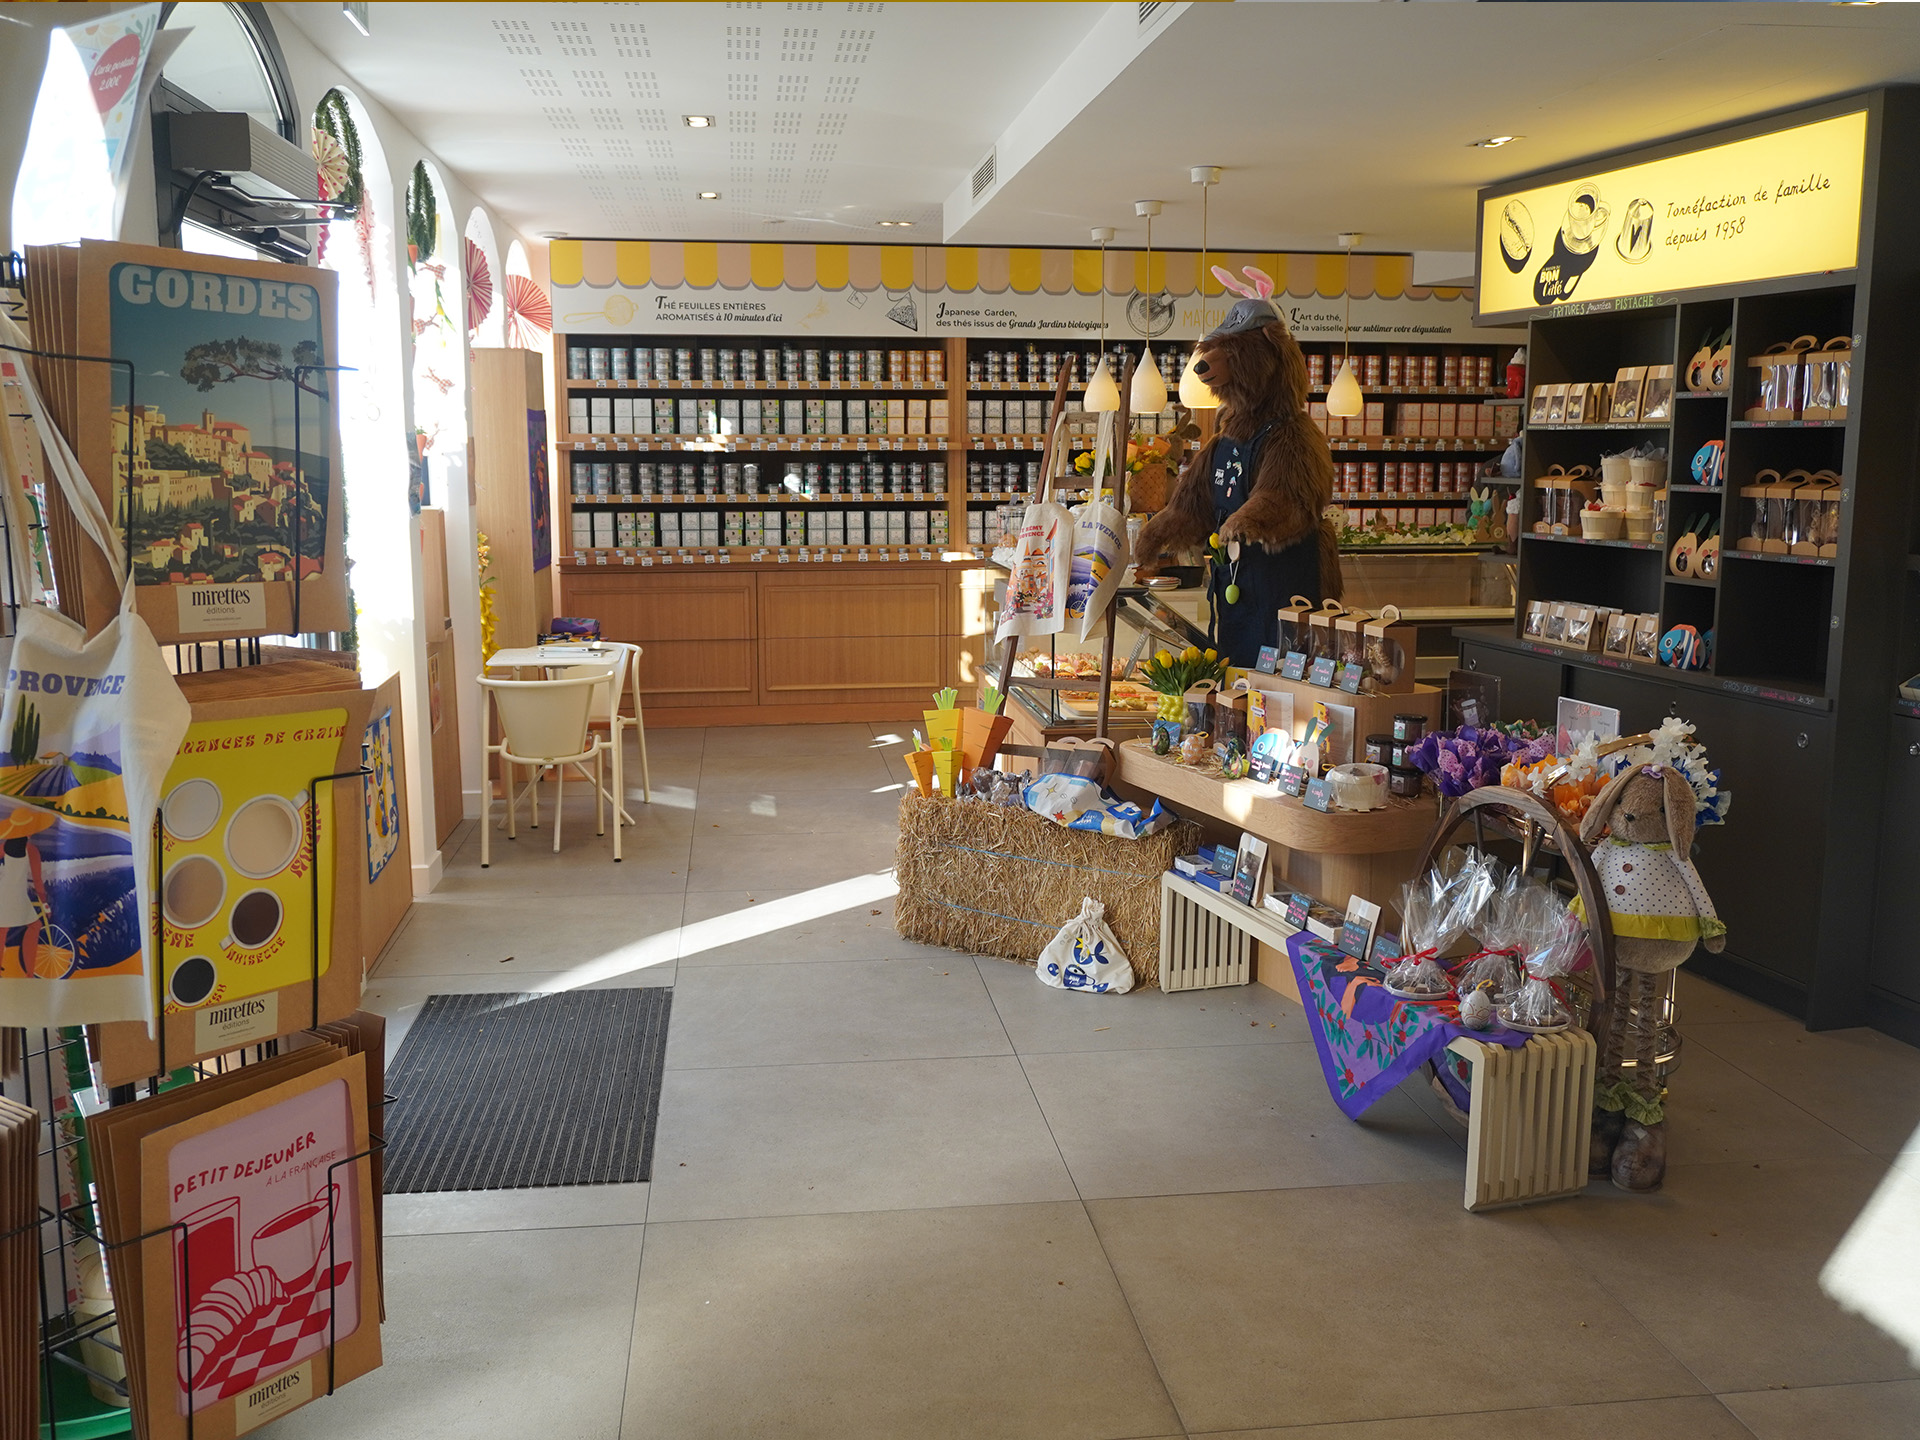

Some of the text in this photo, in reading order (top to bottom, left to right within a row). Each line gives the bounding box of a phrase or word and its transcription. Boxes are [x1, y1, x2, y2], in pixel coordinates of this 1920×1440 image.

[1666, 173, 1831, 219] Torréfaction de famille
[1665, 216, 1746, 251] depuis 1958
[1540, 269, 1560, 283] BON
[118, 265, 313, 321] GORDES
[678, 302, 721, 311] FEUILLES
[722, 300, 766, 311] ENTIÈRES
[936, 302, 1017, 319] Japanese Garden,
[1552, 303, 1585, 318] FRITURES
[1615, 295, 1654, 310] PISTACHE
[655, 311, 714, 321] AROMATISÉS
[716, 313, 722, 322] à
[723, 313, 732, 322] 10
[733, 313, 765, 322] minutes
[936, 319, 951, 328] des
[953, 319, 972, 328] thés
[973, 319, 994, 328] issus
[996, 319, 1007, 328] de
[1008, 319, 1036, 329] Grands
[1037, 319, 1066, 331] Jardins
[1314, 312, 1324, 322] du
[1326, 312, 1342, 323] thé,
[1290, 323, 1452, 335] de la vaisselle pour sublimer votre dégustation
[1082, 521, 1093, 529] LA
[192, 588, 251, 606] mirettes
[206, 606, 235, 615] éditions
[6, 669, 126, 697] PROVENCE
[176, 725, 346, 756] UANCES DE GRAIN
[209, 999, 265, 1025] mirettes
[222, 1019, 250, 1031] éditions
[174, 1131, 317, 1203] PETIT DEJEUNER
[275, 1171, 287, 1184] LA
[289, 1150, 337, 1177] FRANÇAISE
[249, 1371, 300, 1408] mirettes
